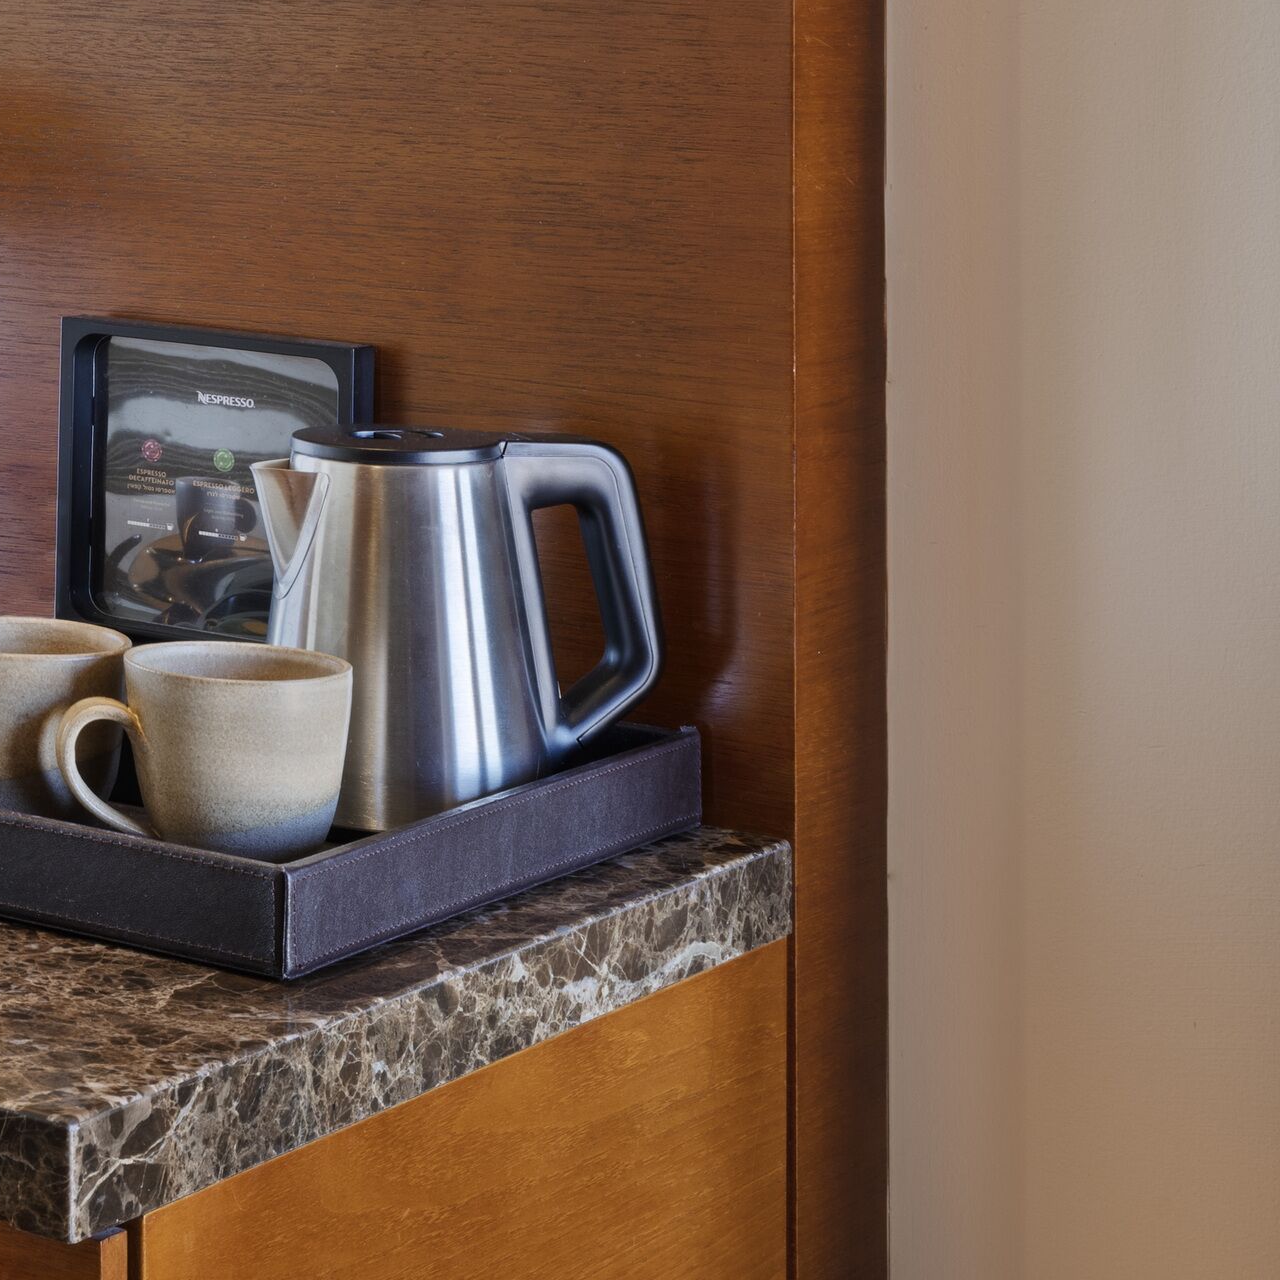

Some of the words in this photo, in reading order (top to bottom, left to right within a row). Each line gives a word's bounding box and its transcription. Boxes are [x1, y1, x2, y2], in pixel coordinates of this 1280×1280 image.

[136, 468, 167, 478] ESPRESSO
[128, 474, 175, 486] DECAFFEINATO
[192, 480, 224, 489] ESPRESSO
[224, 484, 255, 494] LEGGERO
